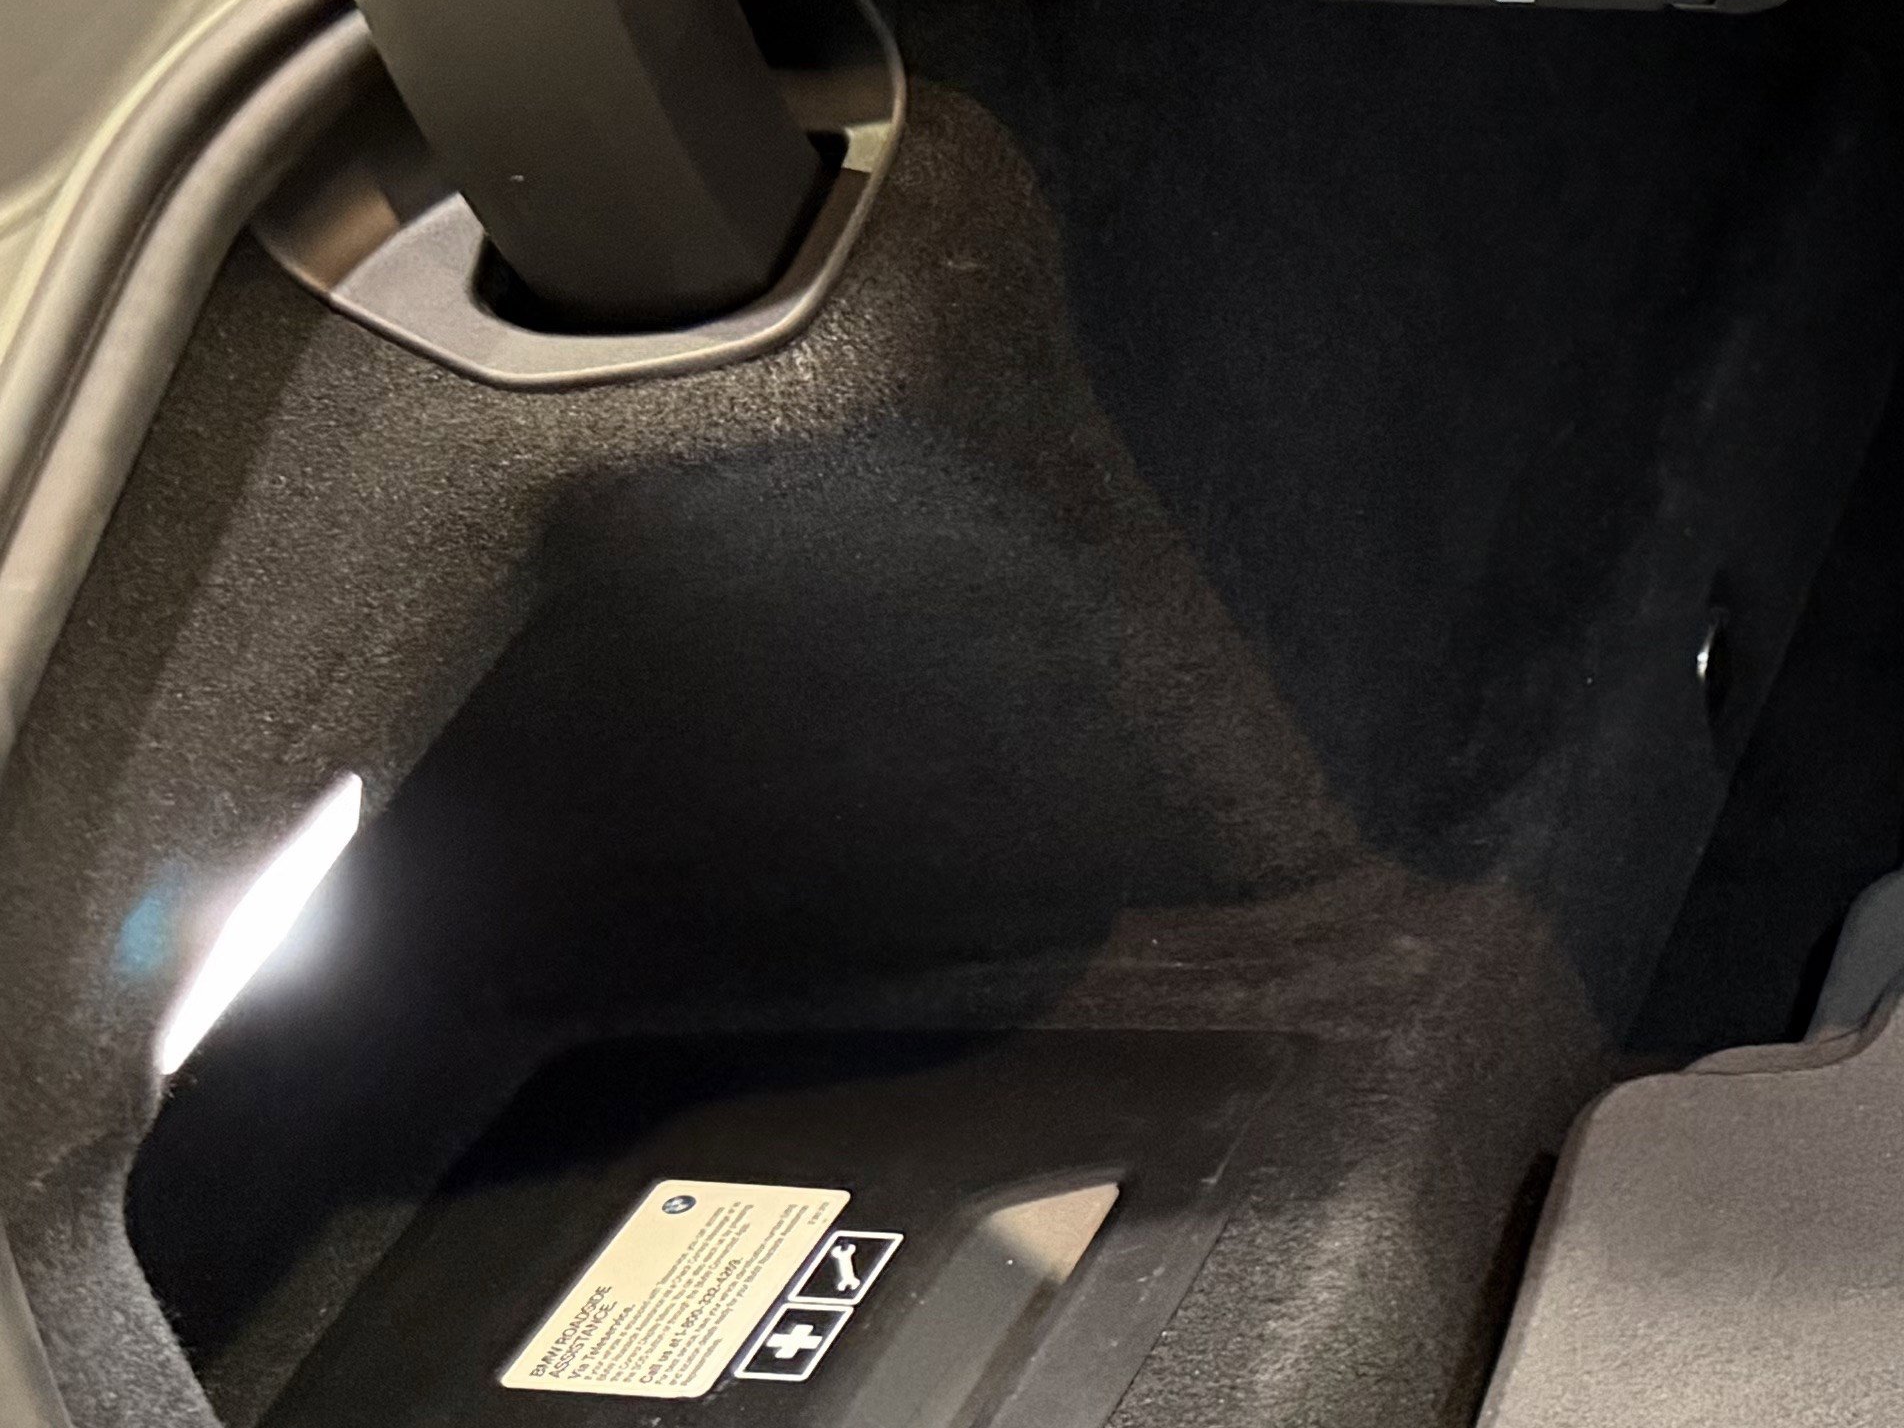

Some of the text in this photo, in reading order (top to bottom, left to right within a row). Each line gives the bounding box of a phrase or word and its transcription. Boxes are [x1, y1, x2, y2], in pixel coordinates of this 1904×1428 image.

[529, 1286, 612, 1377] BMW ROADSIDE
[567, 1363, 590, 1380] Via
[638, 1363, 663, 1384] Call
